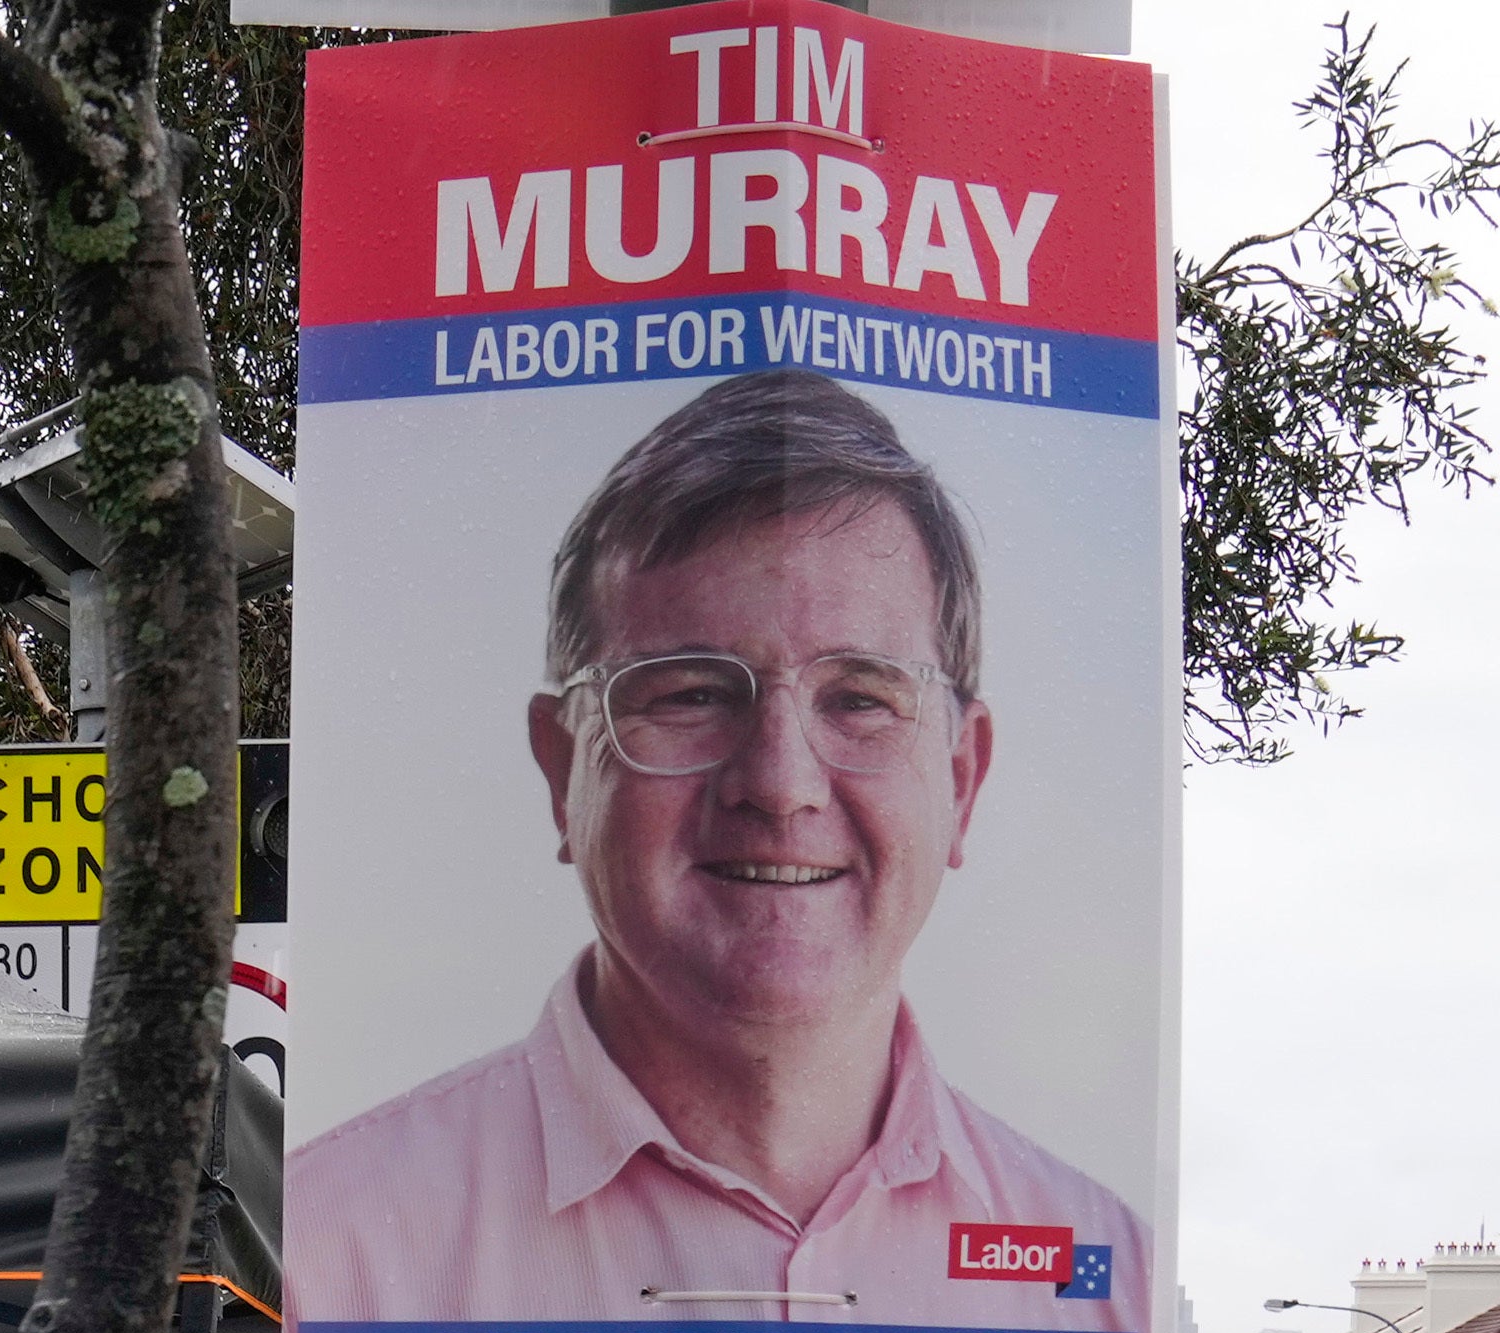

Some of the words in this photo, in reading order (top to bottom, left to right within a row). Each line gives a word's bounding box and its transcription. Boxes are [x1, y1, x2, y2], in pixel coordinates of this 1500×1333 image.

[670, 26, 866, 138] TIM
[436, 148, 1058, 306] MURRAY
[436, 318, 620, 386] LABOR
[635, 309, 745, 371] FOR
[760, 306, 1052, 397] WENTWORTH
[959, 1233, 1059, 1273] Labor
